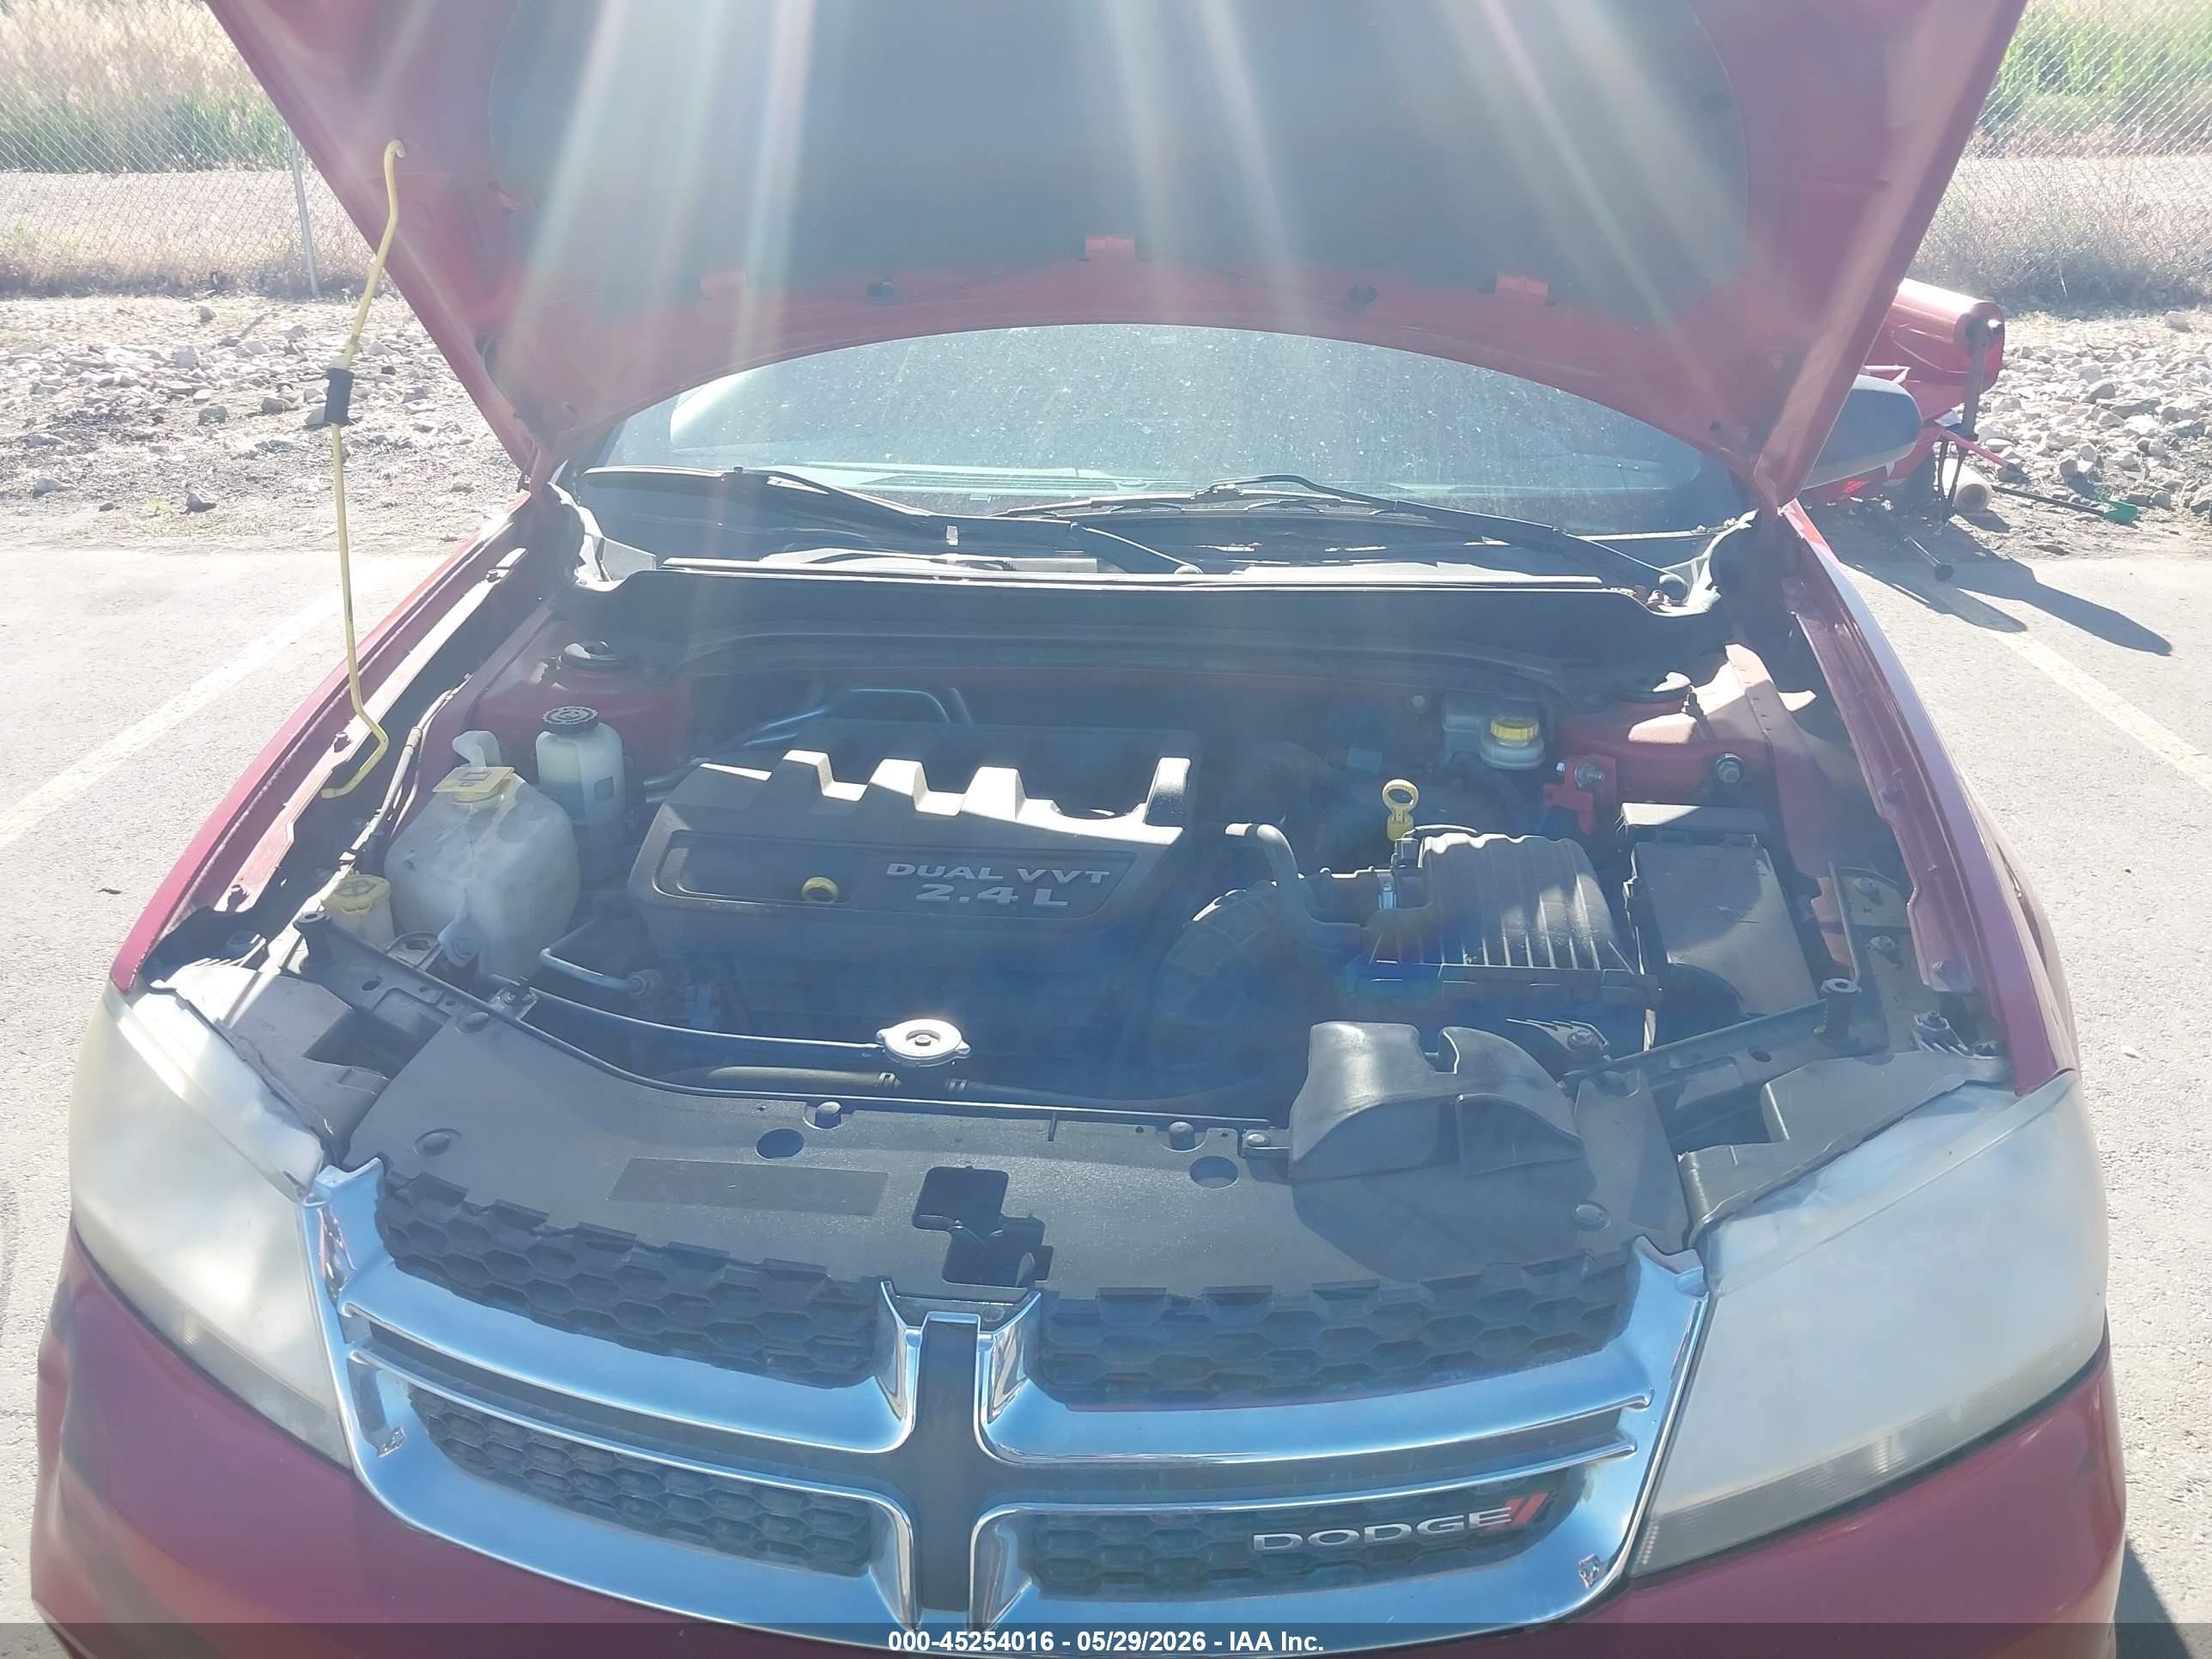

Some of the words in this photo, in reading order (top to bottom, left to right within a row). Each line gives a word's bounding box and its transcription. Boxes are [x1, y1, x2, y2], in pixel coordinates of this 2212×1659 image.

[885, 862, 1004, 880] DUAL
[1017, 868, 1110, 884] VVT
[915, 884, 1019, 906] 2.4
[1033, 888, 1068, 907] L
[1253, 1505, 1512, 1552] DODGE
